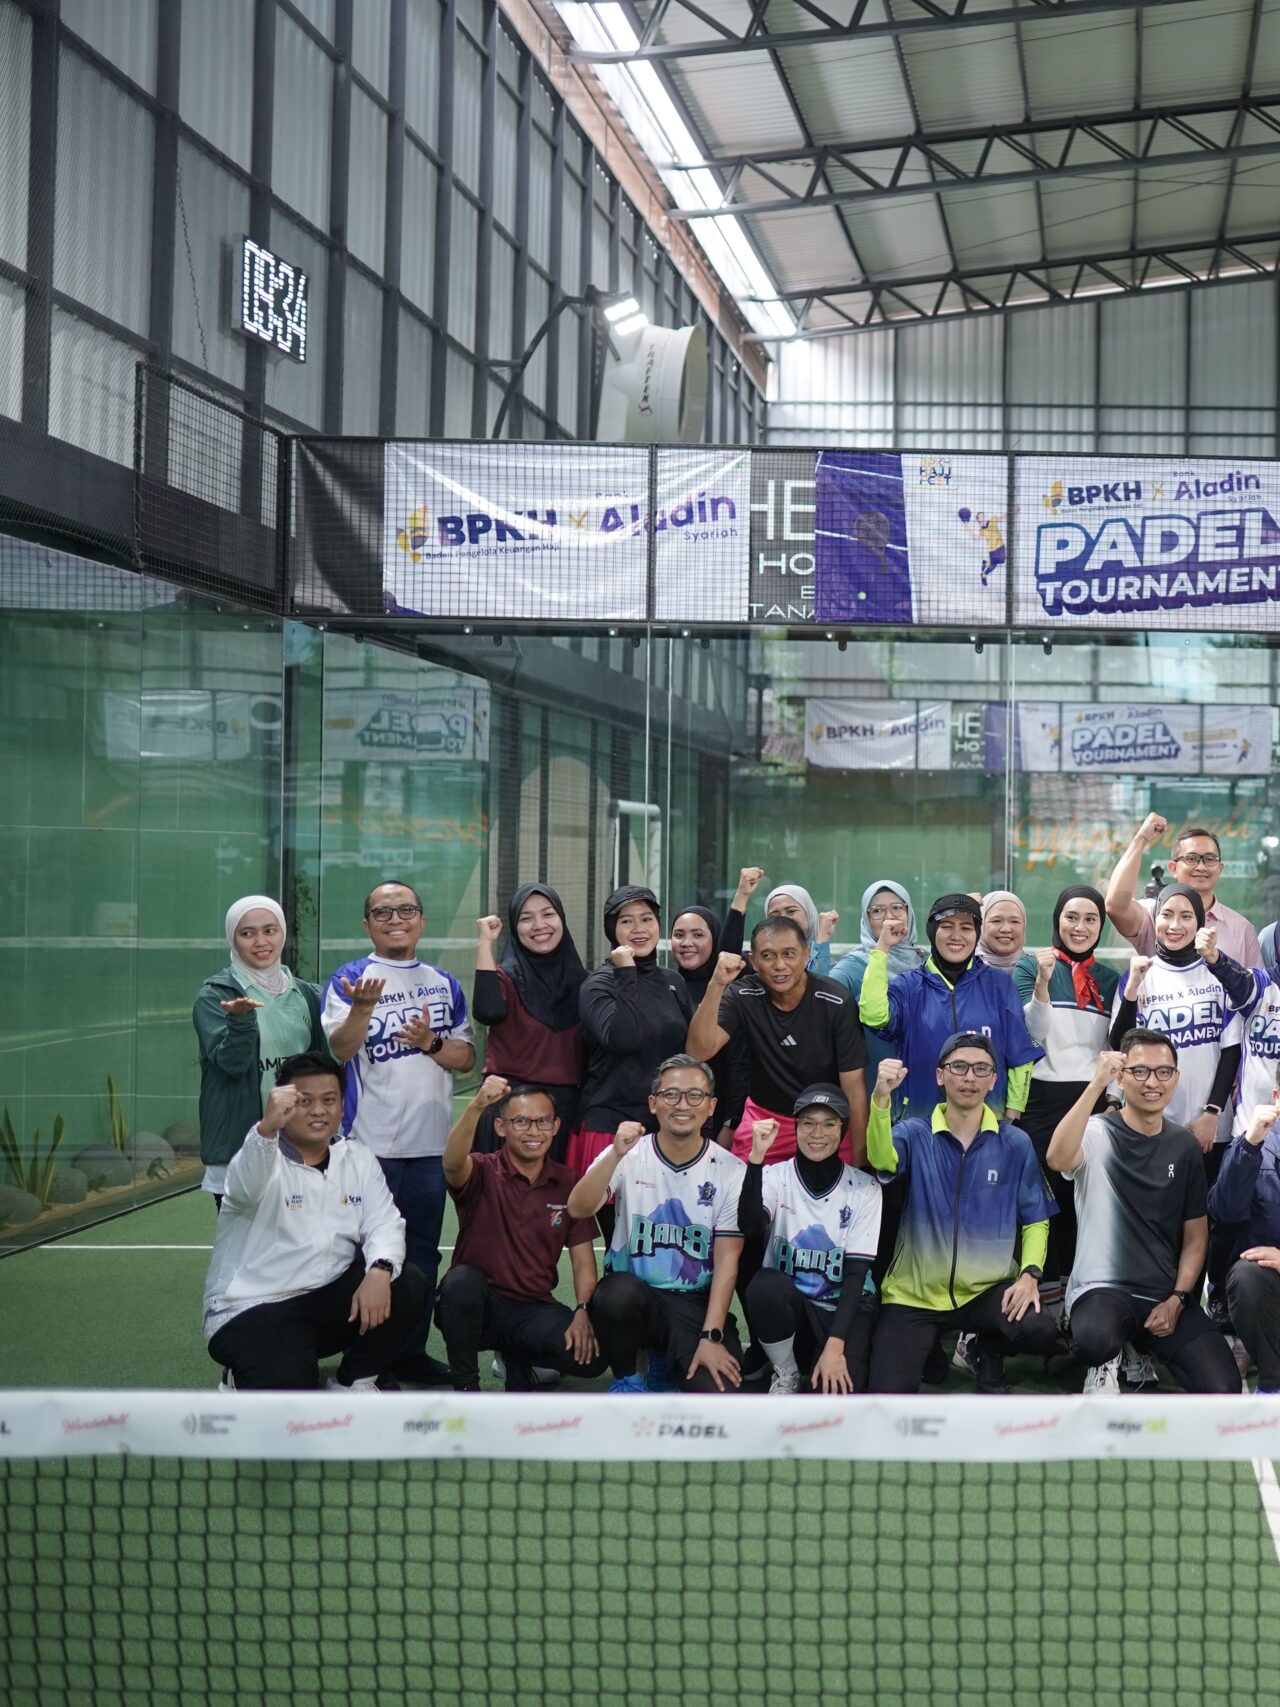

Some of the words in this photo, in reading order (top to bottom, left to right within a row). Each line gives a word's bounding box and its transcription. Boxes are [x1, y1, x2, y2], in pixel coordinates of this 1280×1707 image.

[1067, 480, 1142, 506] BPKH
[1174, 471, 1261, 501] Aladin
[683, 527, 738, 543] Syariah
[1072, 722, 1178, 749] PADEL
[1073, 744, 1182, 766] TOURNAMENT
[1187, 984, 1221, 996] Aladin
[657, 1422, 730, 1440] PADEL
